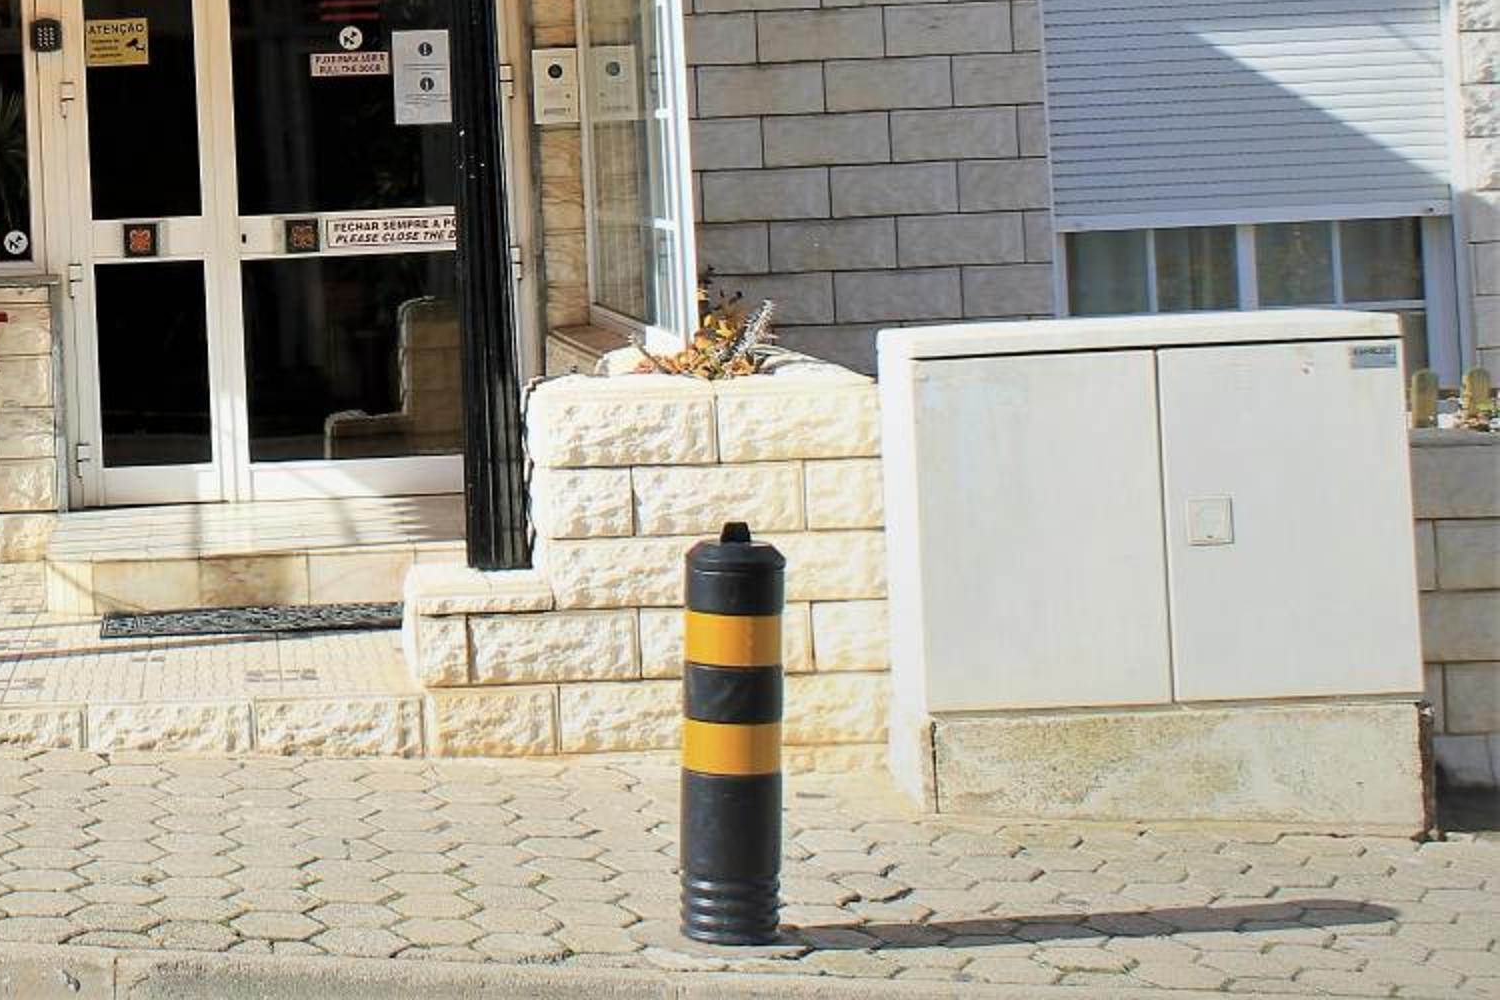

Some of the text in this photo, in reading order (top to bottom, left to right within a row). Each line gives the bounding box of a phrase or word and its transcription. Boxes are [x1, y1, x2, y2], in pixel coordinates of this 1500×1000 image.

[333, 221, 379, 233] FECHAR
[382, 218, 429, 231] SEMPRE
[432, 218, 441, 229] A
[335, 233, 379, 244] PLEASE
[381, 231, 419, 242] CLOSE
[422, 230, 444, 241] THE
